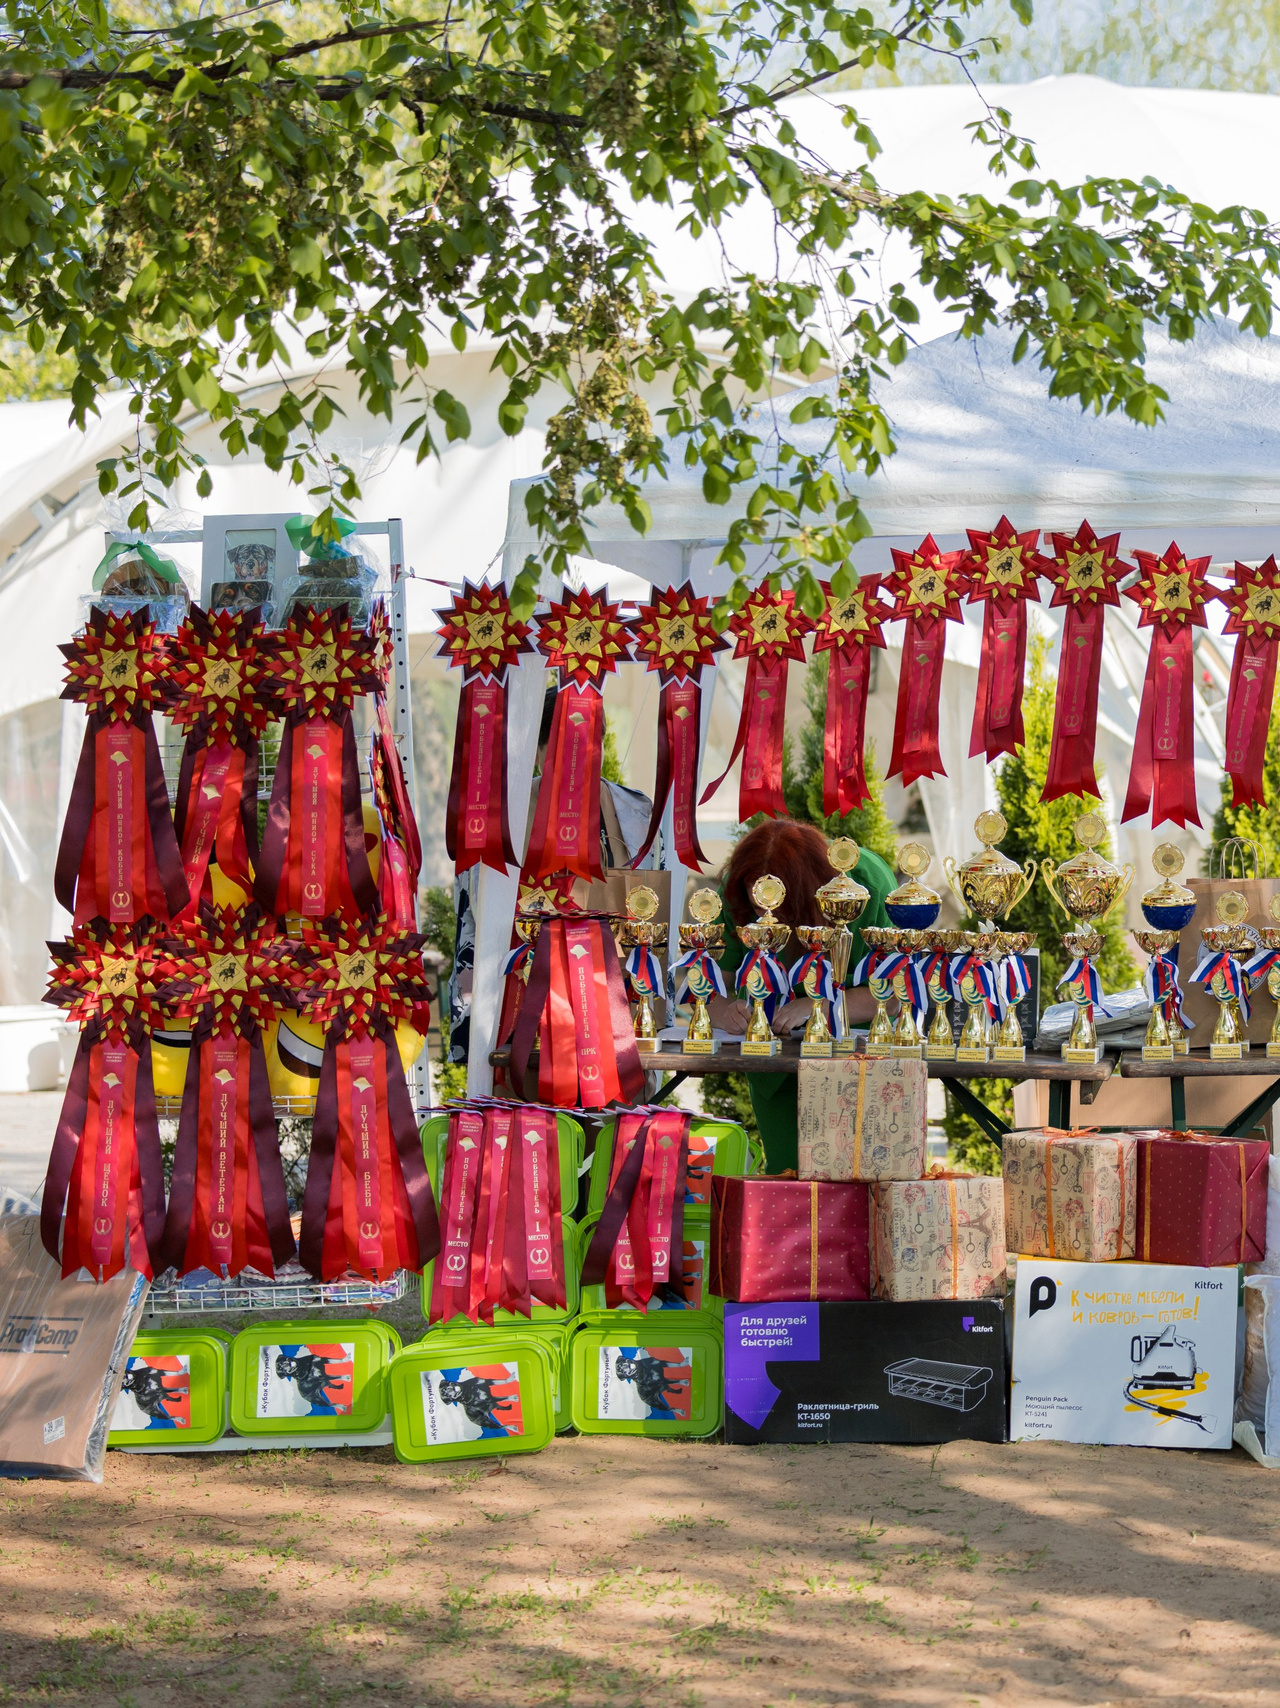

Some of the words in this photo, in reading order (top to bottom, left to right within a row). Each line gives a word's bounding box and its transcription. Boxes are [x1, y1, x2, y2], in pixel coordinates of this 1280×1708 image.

[578, 966, 590, 1039] ПОБЕДИТЕЛЬ
[105, 1099, 115, 1155] ЛУЧШИЙ
[219, 1093, 228, 1148] ЛУЧШИЙ
[360, 1104, 370, 1160] ЛУЧШИЙ
[101, 1162, 111, 1207] ЩЕНОК
[218, 1151, 227, 1213] ВЕТЕРАН
[363, 1171, 372, 1207] БЕБИ
[458, 1157, 470, 1220] ПОБЕДИТЕЛЬ
[531, 1150, 541, 1214] ПОБЕДИТЕЛЬ
[447, 1240, 469, 1248] МЕСТО
[528, 1233, 549, 1242] МЕСТО
[1194, 1280, 1224, 1290] Kitfort
[1070, 1289, 1080, 1307] К
[740, 1316, 763, 1327] Для
[765, 1315, 807, 1328] друзей
[1089, 1308, 1140, 1326] КОВРОВ
[740, 1328, 788, 1336] готовлю
[971, 1325, 994, 1333] Kitfort
[740, 1336, 793, 1348] быстрей!
[797, 1402, 880, 1412] Раклетница-гриль
[1025, 1395, 1052, 1404] Penguin
[1024, 1403, 1055, 1412] Моющий
[1024, 1421, 1053, 1430] kitfort.ru
